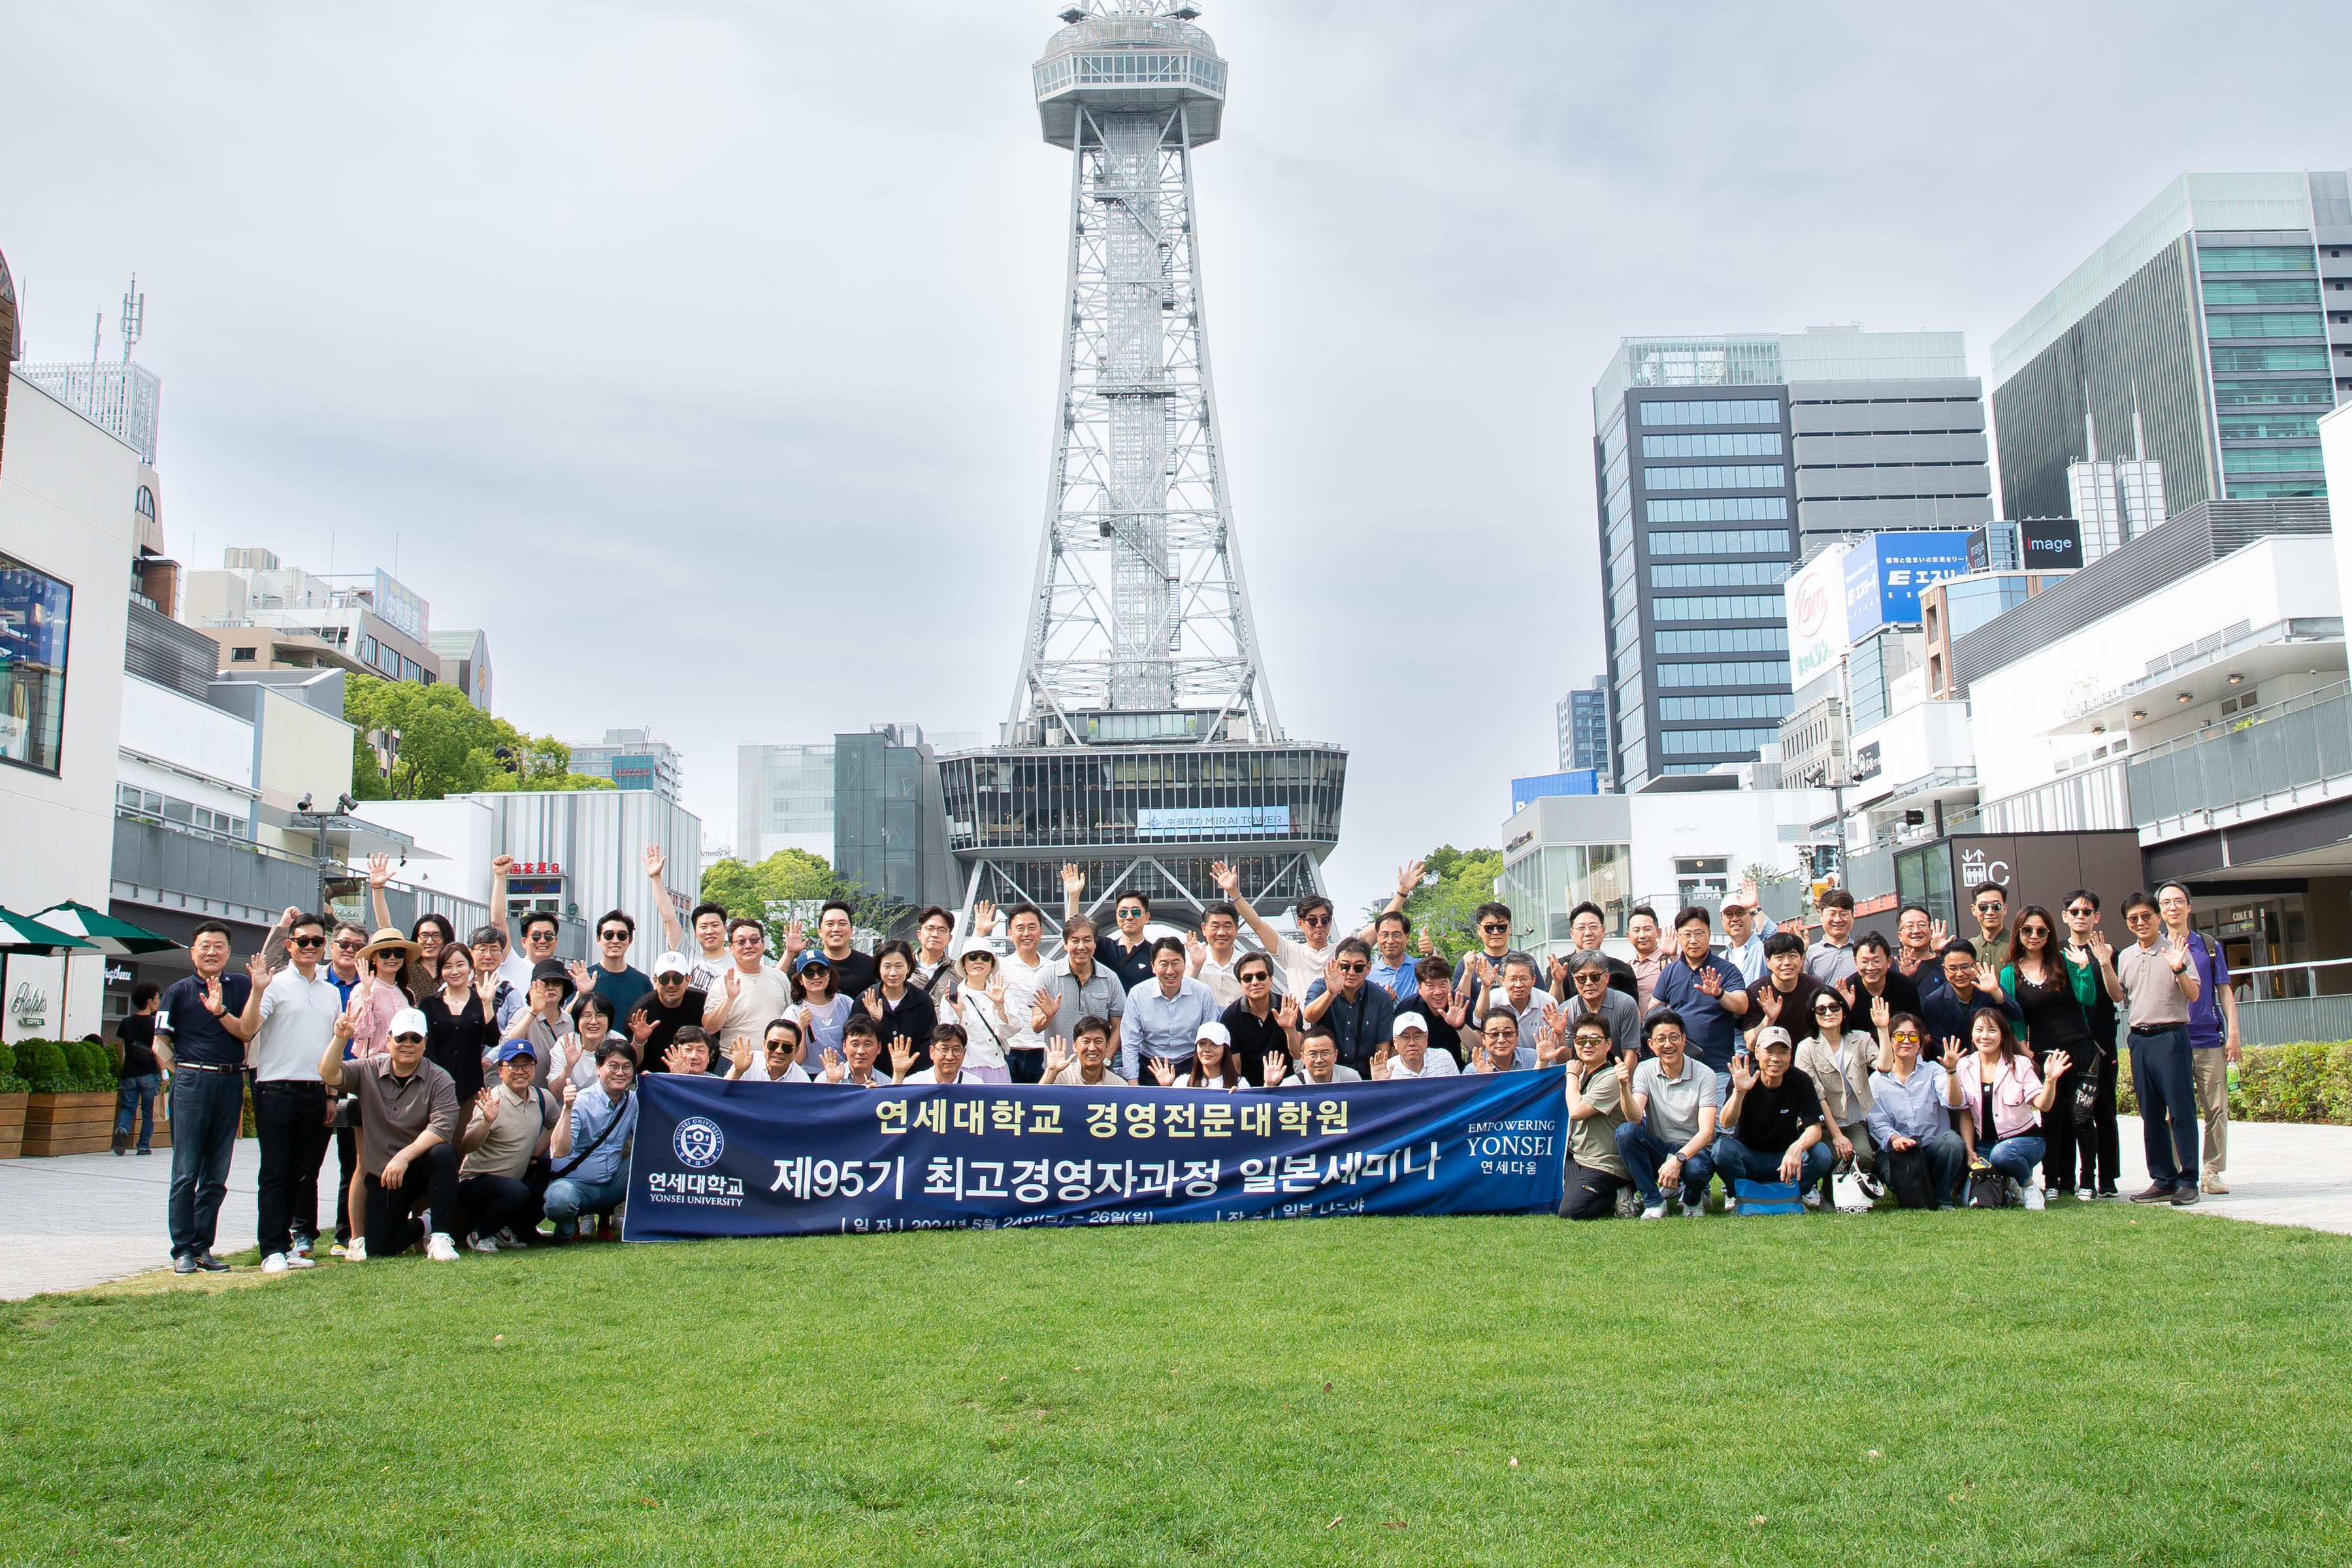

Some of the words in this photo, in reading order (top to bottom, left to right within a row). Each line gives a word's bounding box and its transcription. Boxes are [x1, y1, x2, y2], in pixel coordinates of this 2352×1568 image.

[2028, 537, 2072, 552] Image
[1168, 817, 1203, 825] 中部電力
[1241, 815, 1282, 824] TOWER
[1988, 860, 2010, 887] C
[875, 1099, 1064, 1136] 연세대학교
[1086, 1100, 1349, 1138] 경영전문대학원
[1467, 1119, 1556, 1134] EMPOWERING
[1467, 1135, 1554, 1157] YONSEI
[770, 1156, 905, 1200] 제95기
[924, 1156, 1220, 1203] 최고경영자과정
[1239, 1141, 1441, 1193] 일본세미나
[1480, 1160, 1537, 1175] 연세다움
[648, 1173, 745, 1194] 연세대학교
[649, 1194, 685, 1203] YONSEI
[687, 1195, 743, 1207] UNIVERSITY
[1089, 1211, 1154, 1224] 26일(일)
